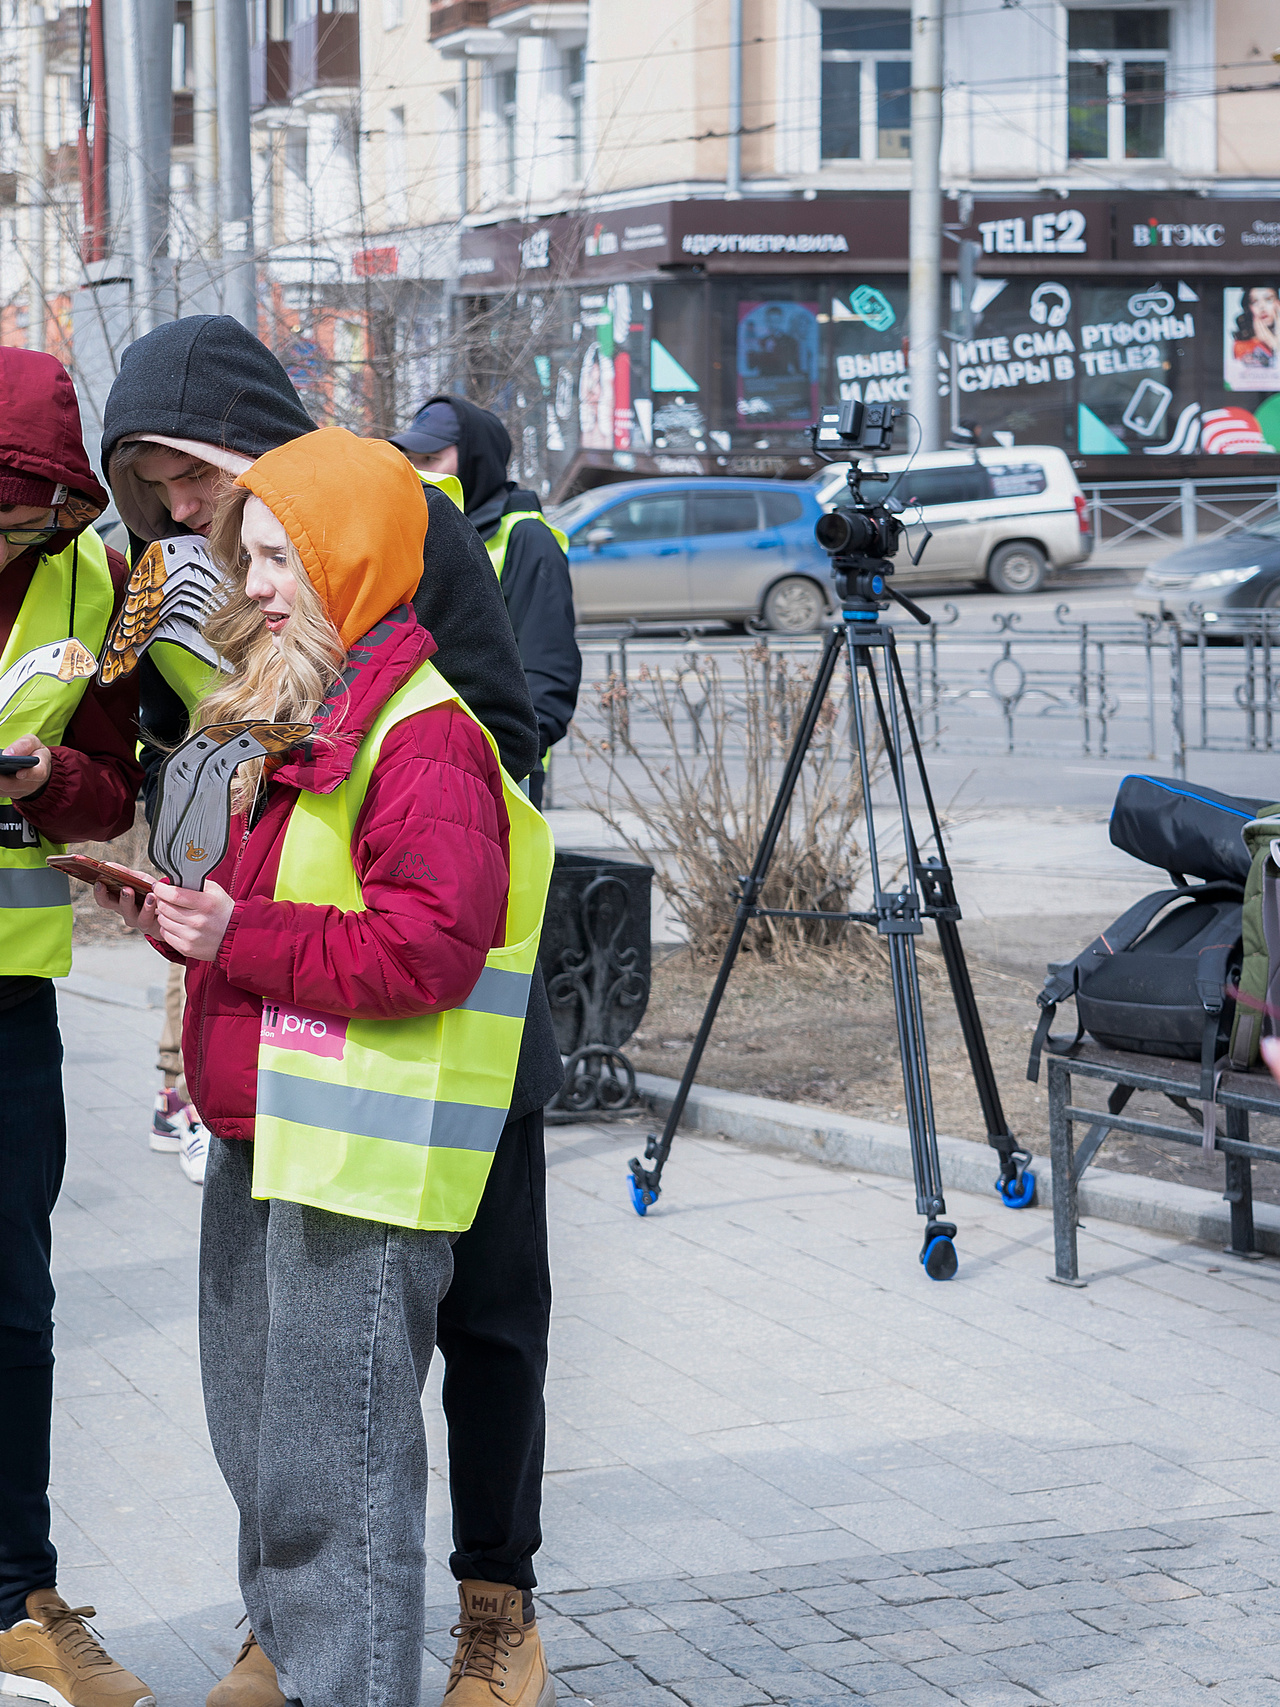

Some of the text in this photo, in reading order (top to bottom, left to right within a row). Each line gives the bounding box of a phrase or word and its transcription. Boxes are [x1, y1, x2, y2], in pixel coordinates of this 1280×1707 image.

[978, 209, 1087, 253] TELE2
[1053, 355, 1076, 380] В
[1079, 344, 1161, 376] TELE2
[282, 1014, 327, 1038] pro
[472, 1594, 498, 1613] HH
